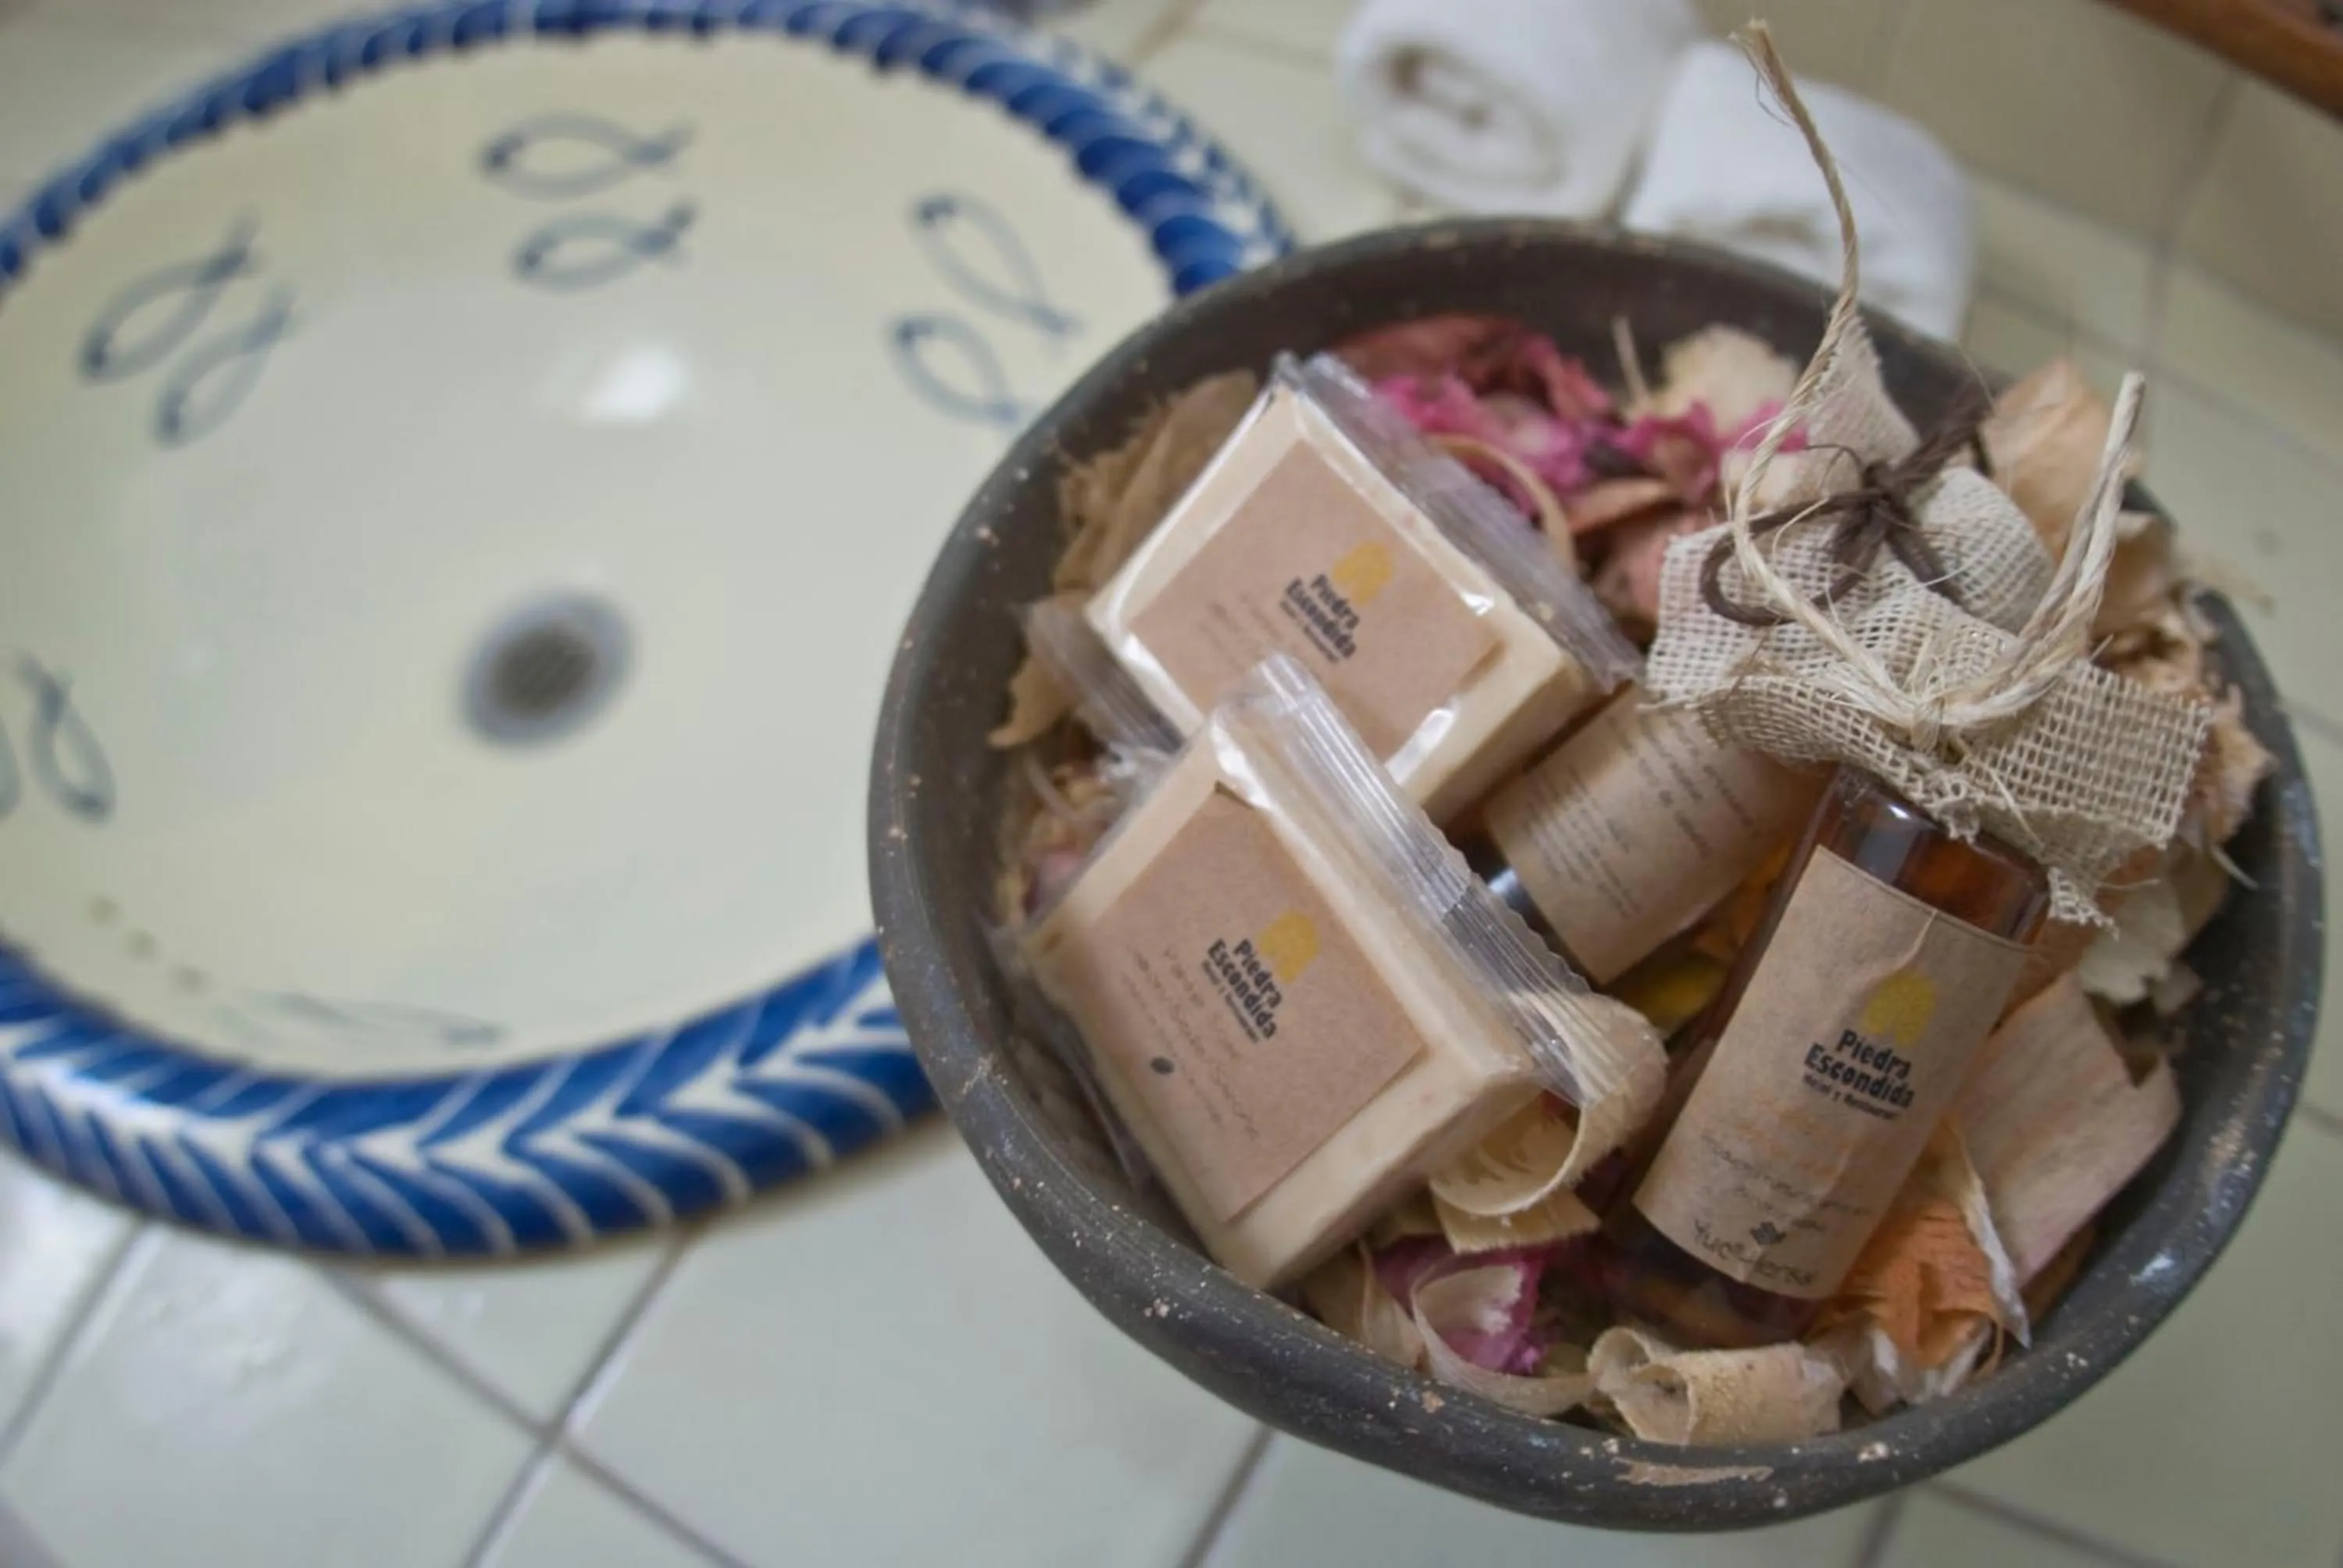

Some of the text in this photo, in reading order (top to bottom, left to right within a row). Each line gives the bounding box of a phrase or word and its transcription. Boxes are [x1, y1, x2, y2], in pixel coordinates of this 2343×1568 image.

[1310, 573, 1360, 631] Piedra
[1207, 939, 1277, 1039] Escondida
[1233, 939, 1282, 1009] Piedra
[1803, 1042, 1915, 1108] Escondida
[1835, 1029, 1912, 1079] Piedra
